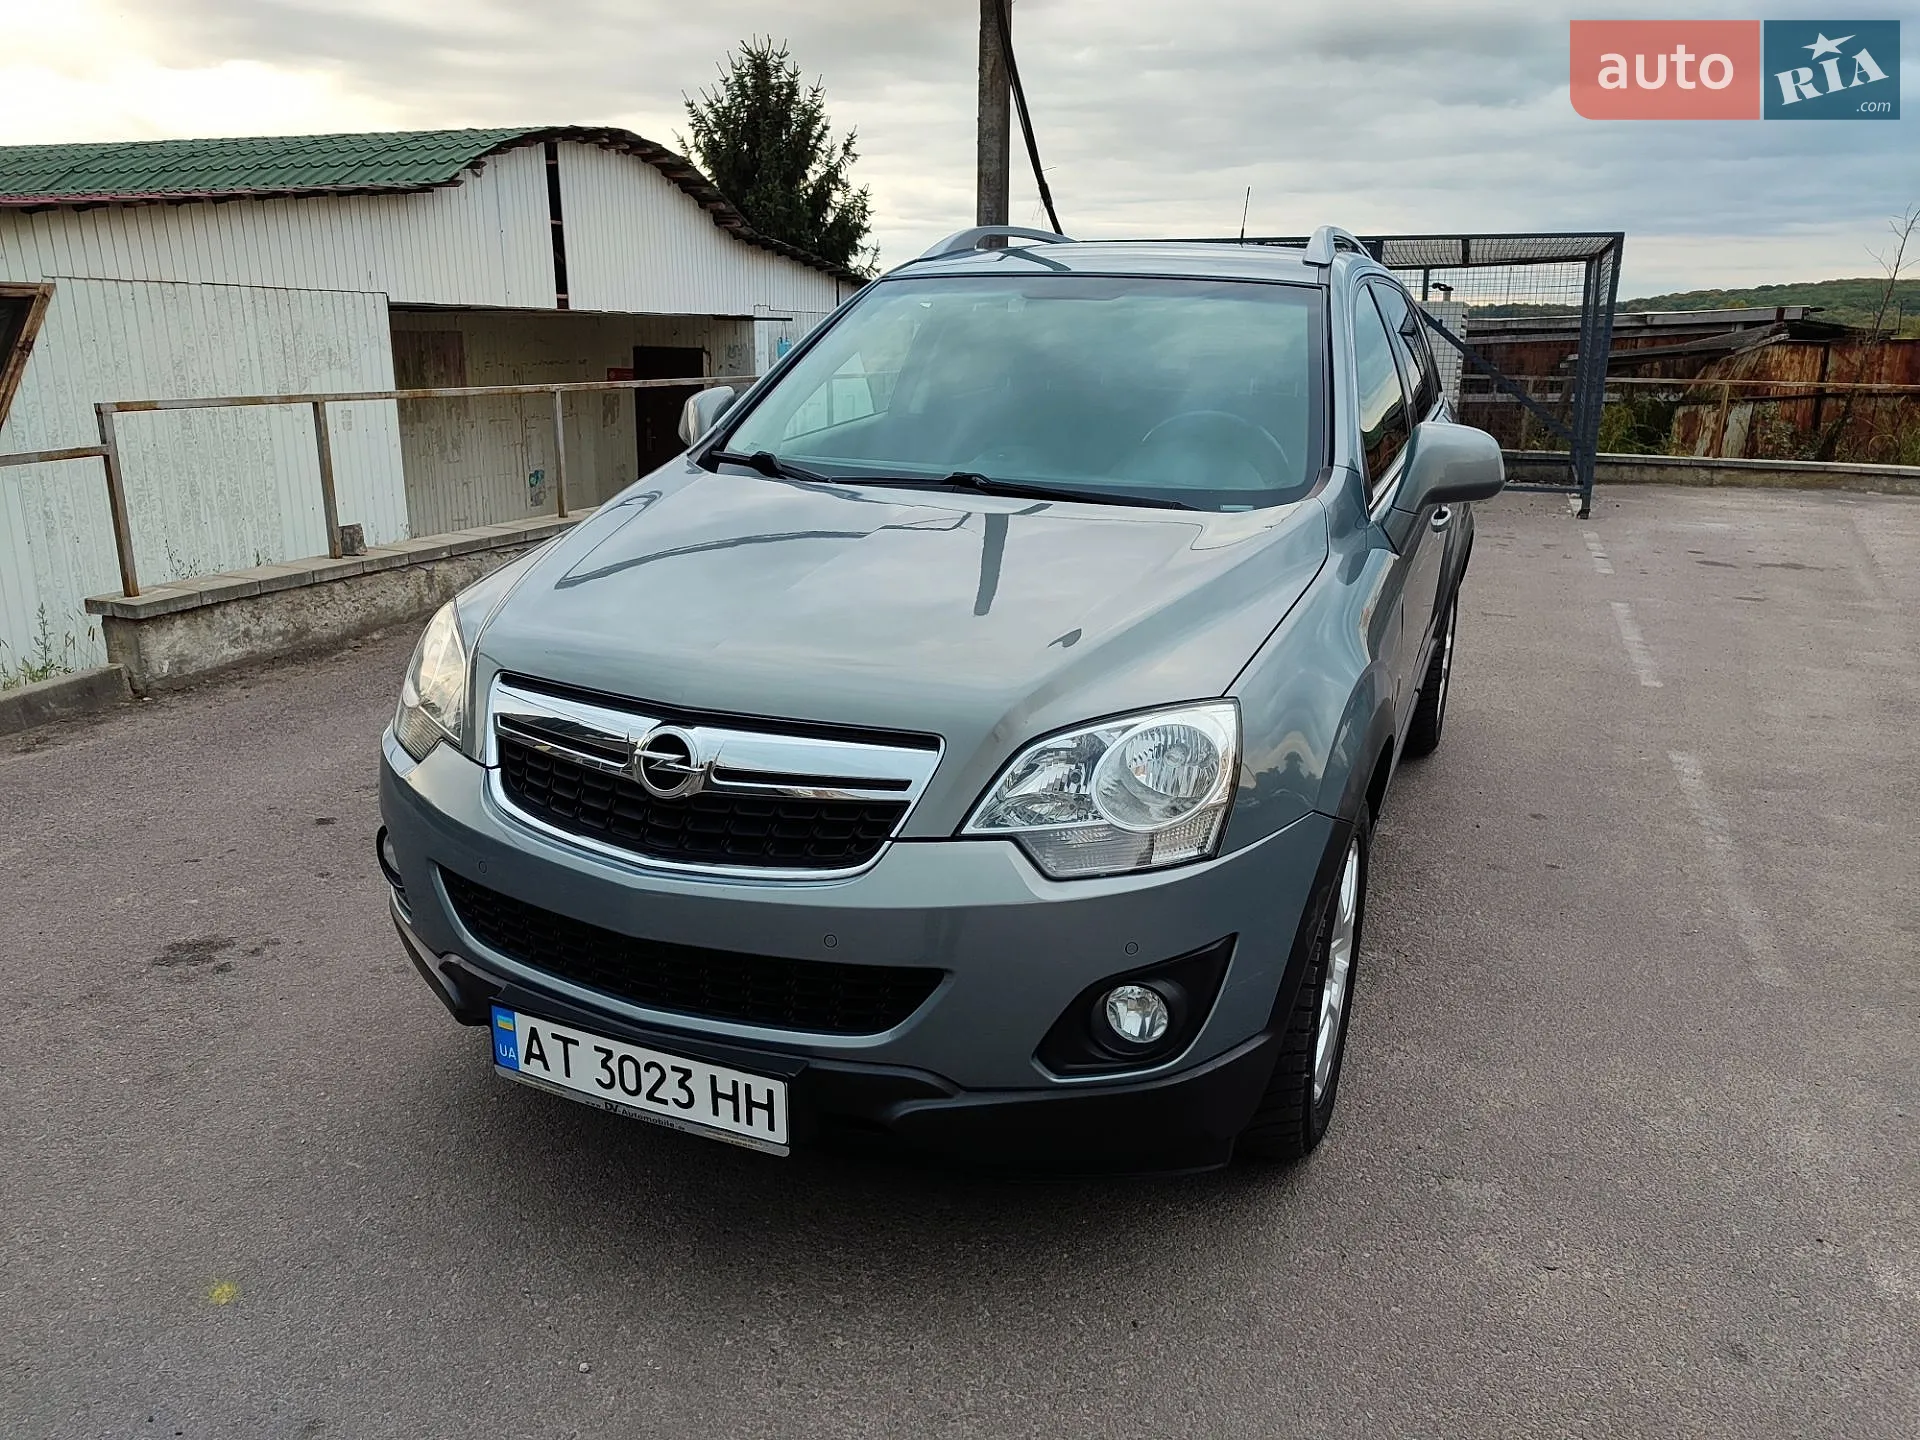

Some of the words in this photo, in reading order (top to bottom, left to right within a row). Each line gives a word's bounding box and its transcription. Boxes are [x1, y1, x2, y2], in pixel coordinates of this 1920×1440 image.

[498, 1046, 517, 1060] UA
[523, 1026, 580, 1079] AT
[593, 1045, 695, 1110] 3023
[709, 1074, 775, 1132] HH
